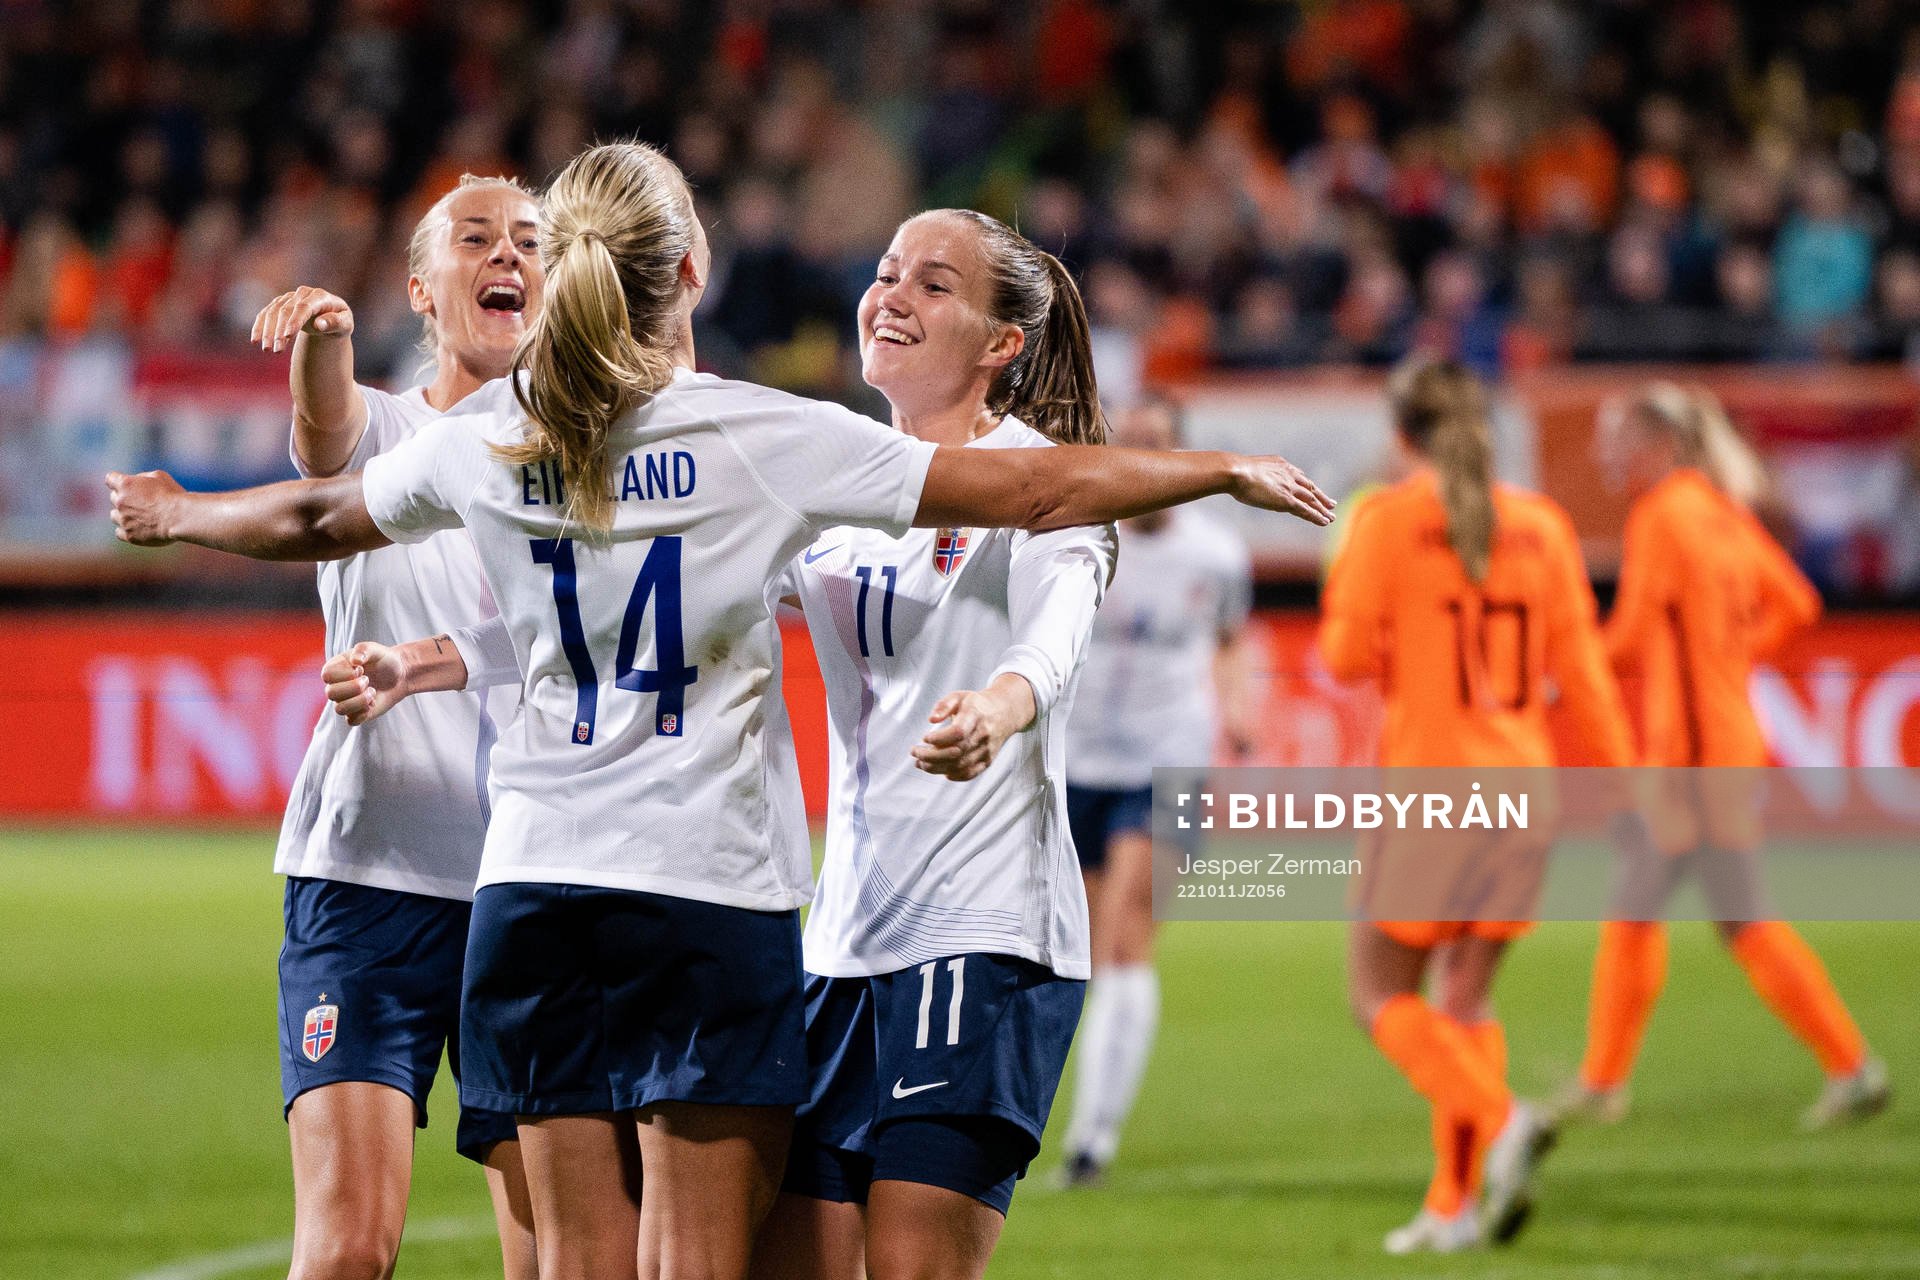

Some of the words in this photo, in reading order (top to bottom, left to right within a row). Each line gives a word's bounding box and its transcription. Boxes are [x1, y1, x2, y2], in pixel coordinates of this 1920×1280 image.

[522, 451, 696, 506] EIAND
[529, 536, 698, 745] 14
[855, 565, 898, 658] 11
[1441, 600, 1528, 709] 10
[915, 957, 966, 1049] 11
